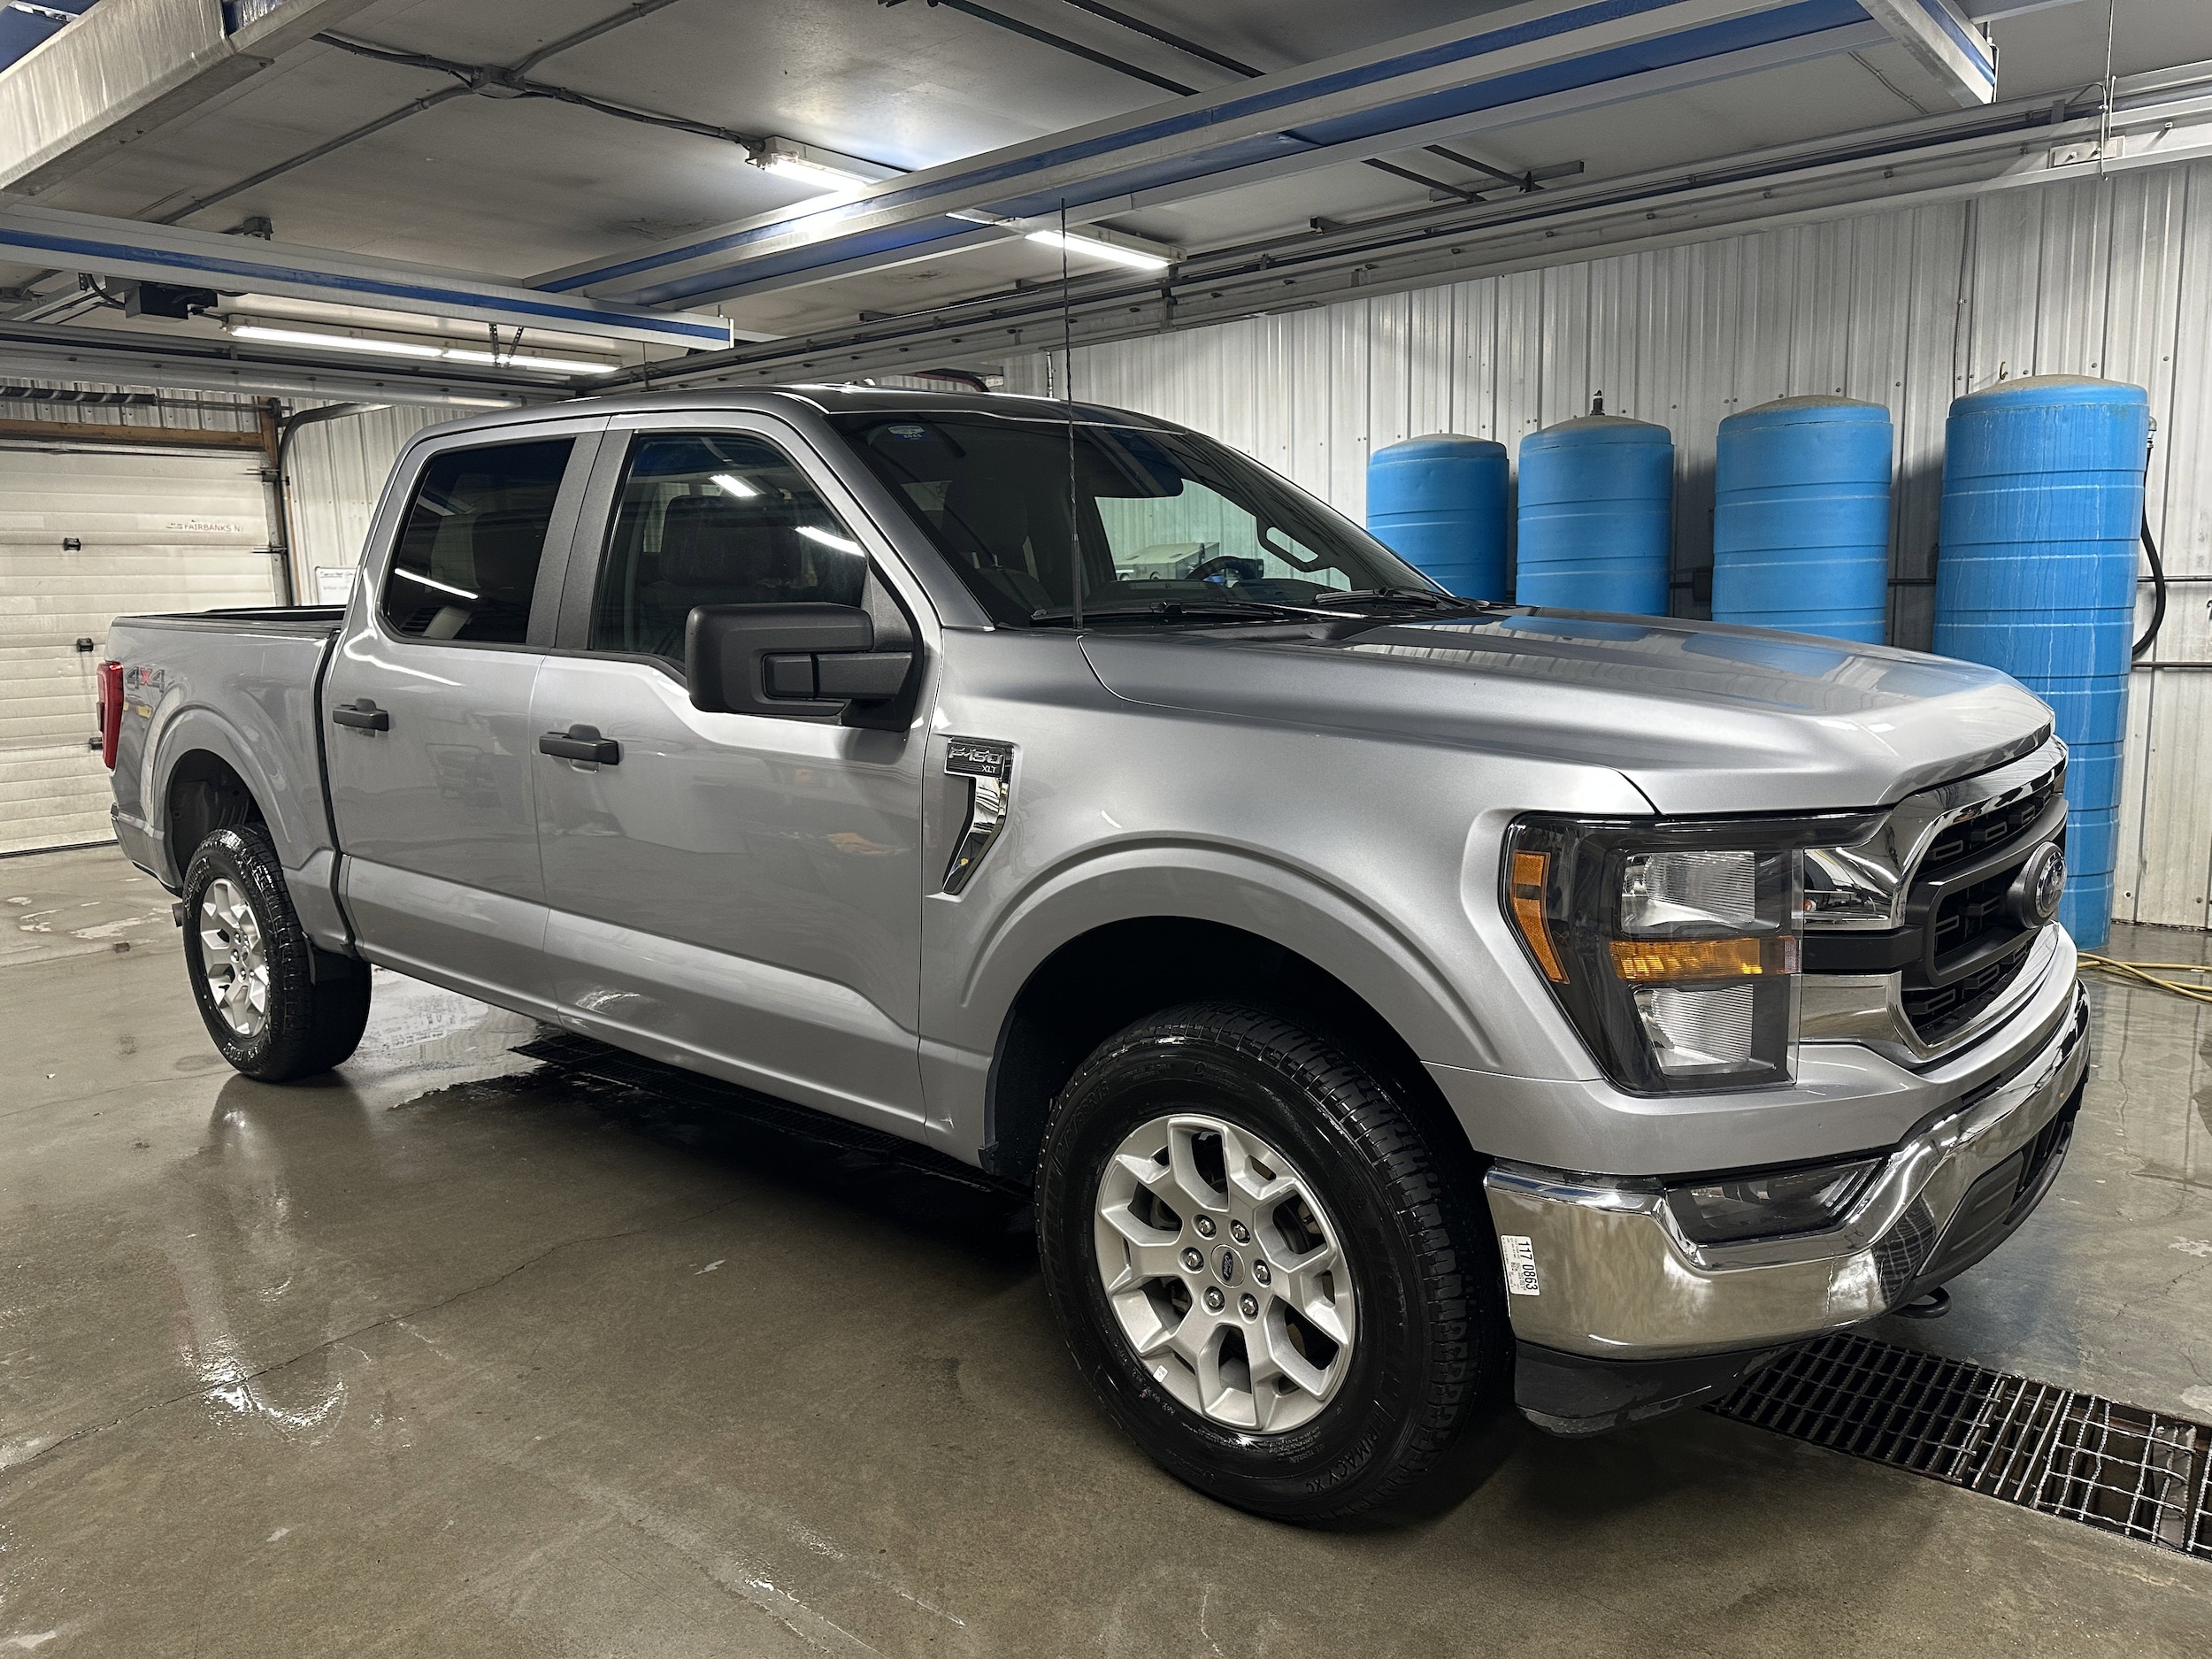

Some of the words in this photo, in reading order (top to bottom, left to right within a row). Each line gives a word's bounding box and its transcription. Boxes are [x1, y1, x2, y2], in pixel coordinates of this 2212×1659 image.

[184, 523, 232, 532] FAIRBANKS
[949, 747, 1003, 764] F-150
[981, 764, 997, 773] XLT
[1518, 1241, 1532, 1261] 117
[1522, 1264, 1539, 1290] 0863
